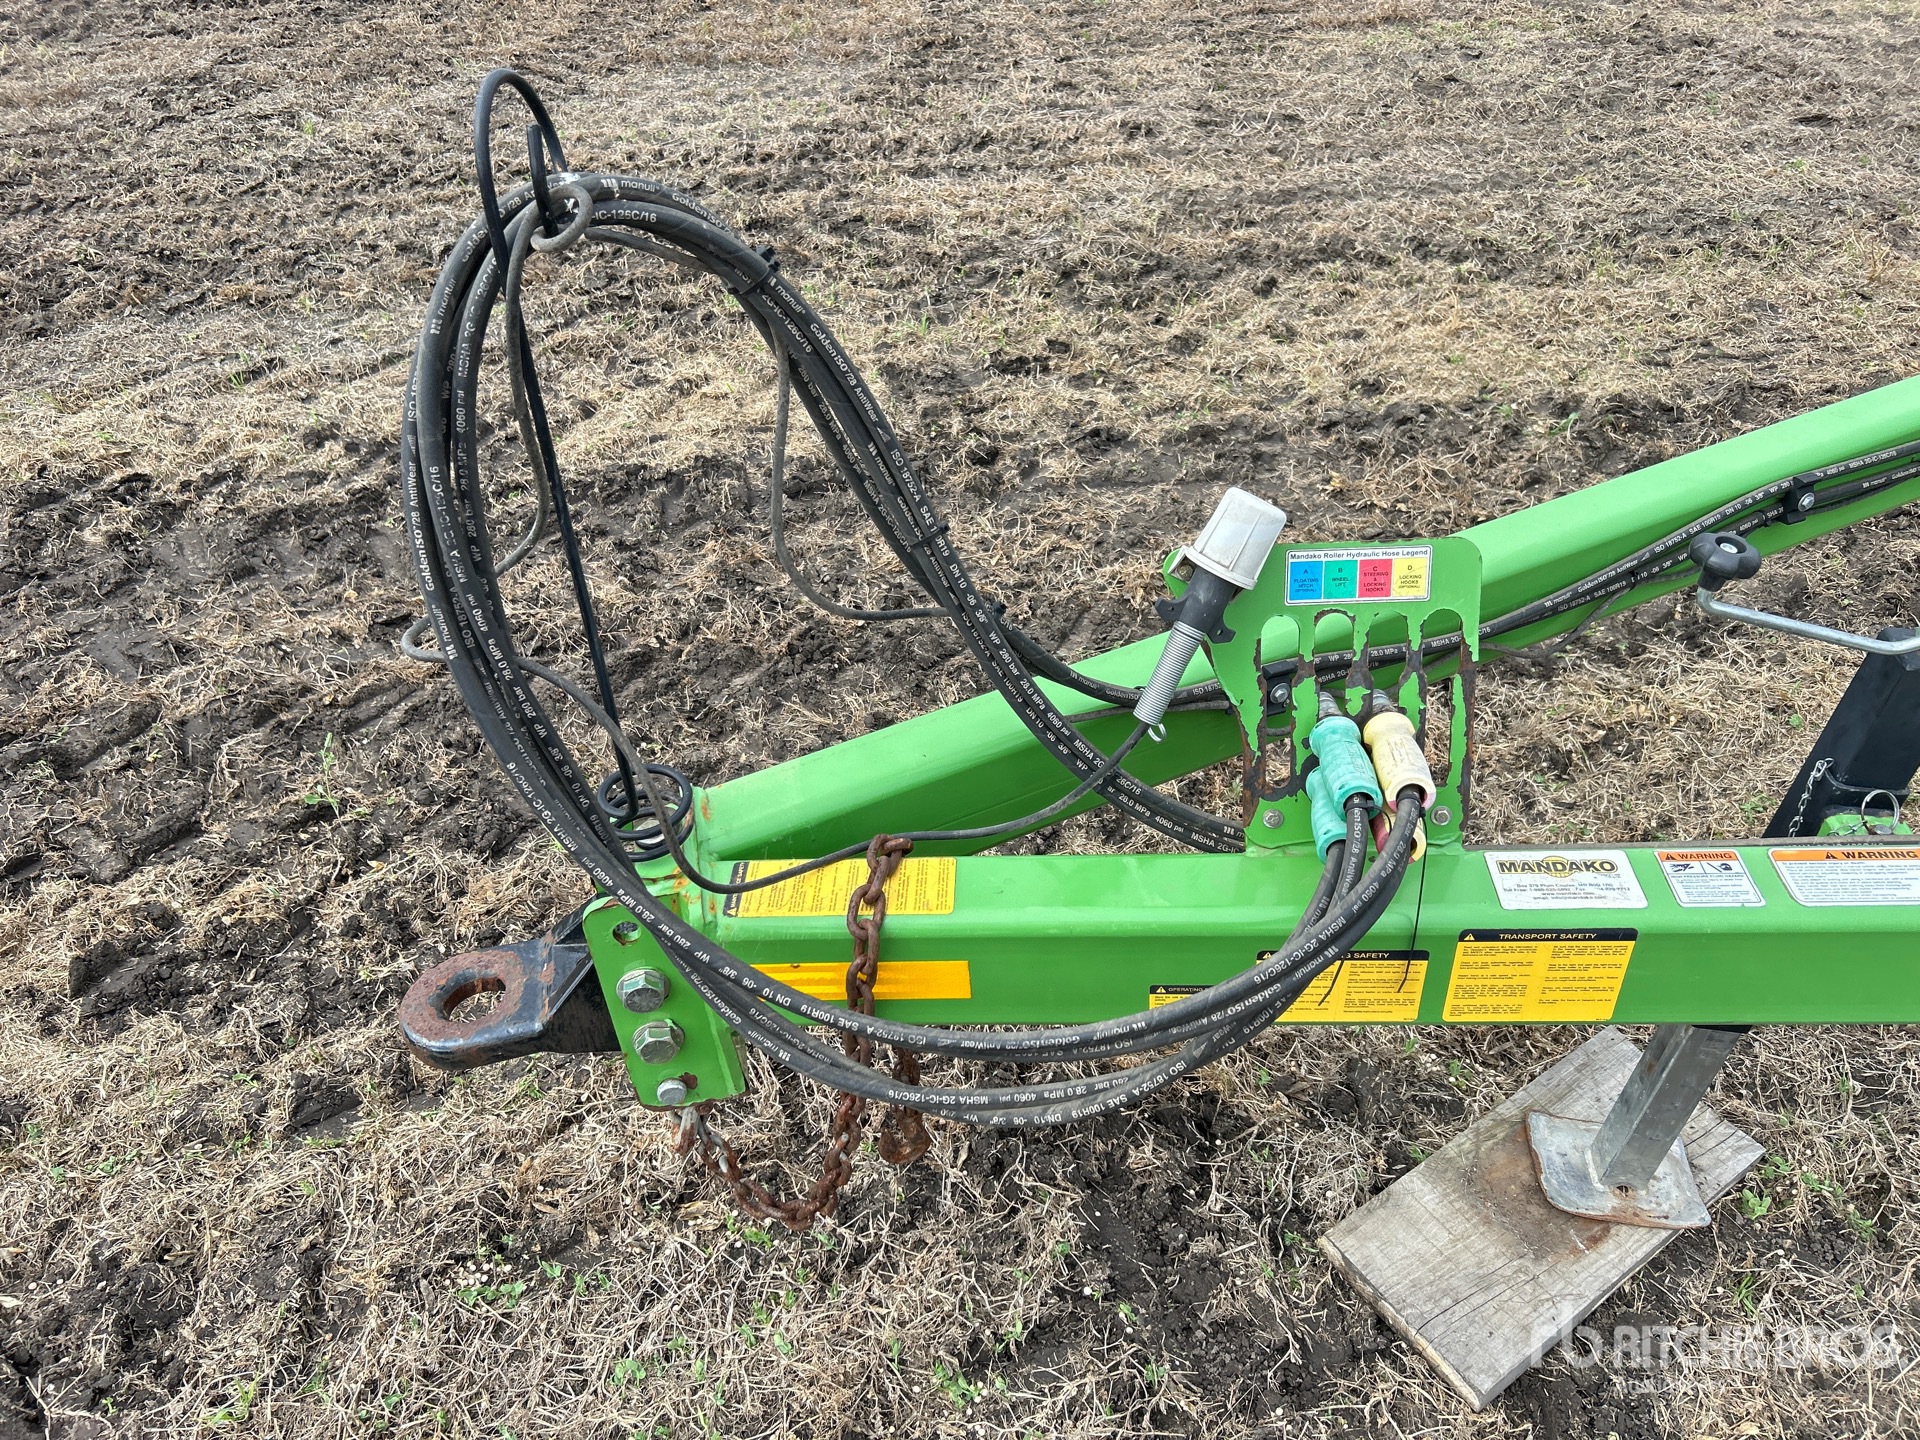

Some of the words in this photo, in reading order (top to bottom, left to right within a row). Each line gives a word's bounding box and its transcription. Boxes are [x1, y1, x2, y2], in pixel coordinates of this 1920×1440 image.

[407, 461, 420, 508] AntiWear
[1768, 485, 1779, 494] WP
[1346, 551, 1380, 559] Hydraulic
[1401, 549, 1428, 557] Legend
[1677, 552, 1688, 562] WP
[890, 449, 904, 467] ISO
[899, 466, 921, 503] 18752-A
[920, 505, 935, 526] SAE
[949, 563, 962, 579] DN
[957, 575, 968, 589] 10
[966, 592, 978, 607] -06
[988, 630, 1001, 646] WP
[999, 648, 1011, 664] 280
[1009, 661, 1021, 677] bar
[1019, 678, 1034, 696] 28.0
[1031, 693, 1046, 711] MPa
[1047, 711, 1063, 730] 4060
[1061, 726, 1072, 738] psi
[1073, 739, 1094, 760] MSHA
[488, 638, 503, 660] MPa
[1328, 655, 1340, 663] WP
[1384, 648, 1399, 657] MPa
[1430, 638, 1450, 649] MSHA
[498, 660, 514, 681] 28.0
[512, 686, 526, 702] bar
[1192, 687, 1204, 696] ISO
[521, 701, 537, 719] 280
[533, 723, 548, 739] WP
[1025, 706, 1037, 721] DN
[1075, 758, 1089, 772] WP
[1118, 792, 1135, 808] 28.0
[1134, 801, 1151, 818] MPa
[1154, 814, 1174, 830] 4060
[1173, 823, 1184, 833] psi
[1190, 831, 1216, 848] MSHA
[553, 823, 579, 852] MSHA
[1841, 851, 1918, 859] WARNING
[1380, 855, 1399, 878] MPa
[1497, 859, 1617, 874] MANDAKO
[592, 866, 614, 888] 4060
[615, 888, 637, 908] MPa
[634, 905, 656, 923] 28.0
[1319, 916, 1347, 942] MSHA
[694, 951, 711, 964] WP
[742, 977, 757, 989] -06
[762, 987, 776, 998] 10
[775, 995, 792, 1008] DN
[800, 1004, 835, 1024] 100R19
[837, 1017, 859, 1031] SAE
[1169, 1060, 1187, 1076] ISO
[1067, 1085, 1087, 1097] 28.0
[1094, 1082, 1110, 1091] bar
[1132, 1072, 1169, 1097] 18752-A
[959, 1094, 988, 1105] MSHA
[1013, 1093, 1037, 1103] 4060
[1044, 1087, 1064, 1099] MPa
[1105, 1094, 1128, 1109] SAE
[1048, 1113, 1062, 1123] DN
[1071, 1103, 1106, 1119] 100R19
[1013, 1117, 1028, 1125] -06
[1034, 1116, 1046, 1124] 10
